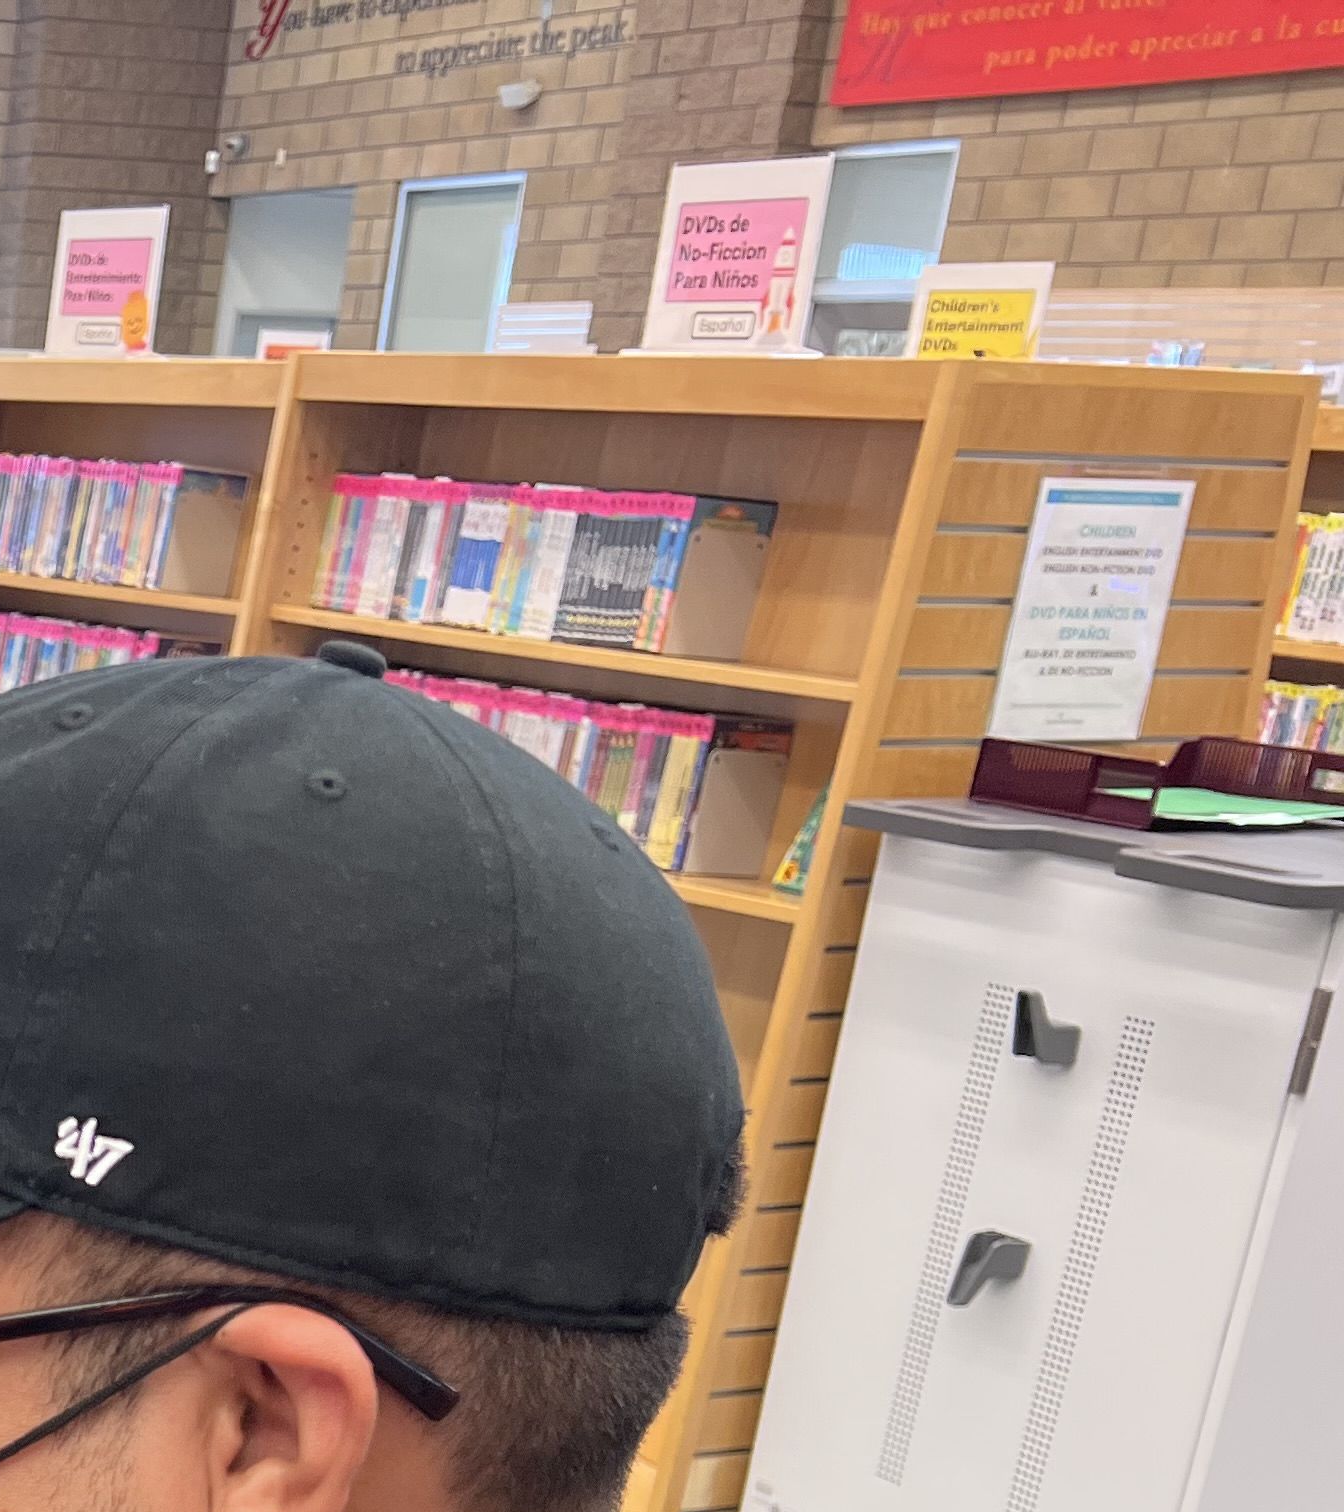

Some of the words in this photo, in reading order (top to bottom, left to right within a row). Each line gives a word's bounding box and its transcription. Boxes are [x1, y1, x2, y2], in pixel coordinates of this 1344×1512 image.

[418, 30, 526, 78] appreciate
[528, 18, 567, 54] the
[982, 49, 1037, 76] para
[1044, 33, 1120, 71] poder
[1128, 23, 1239, 61] apreciar
[1250, 26, 1263, 43] a
[1277, 14, 1303, 40] la
[681, 215, 725, 235] DVDs
[729, 213, 750, 233] de
[673, 270, 708, 289] Para
[712, 269, 759, 289] Niños
[930, 299, 1000, 313] Children's
[922, 337, 958, 352] DVDs
